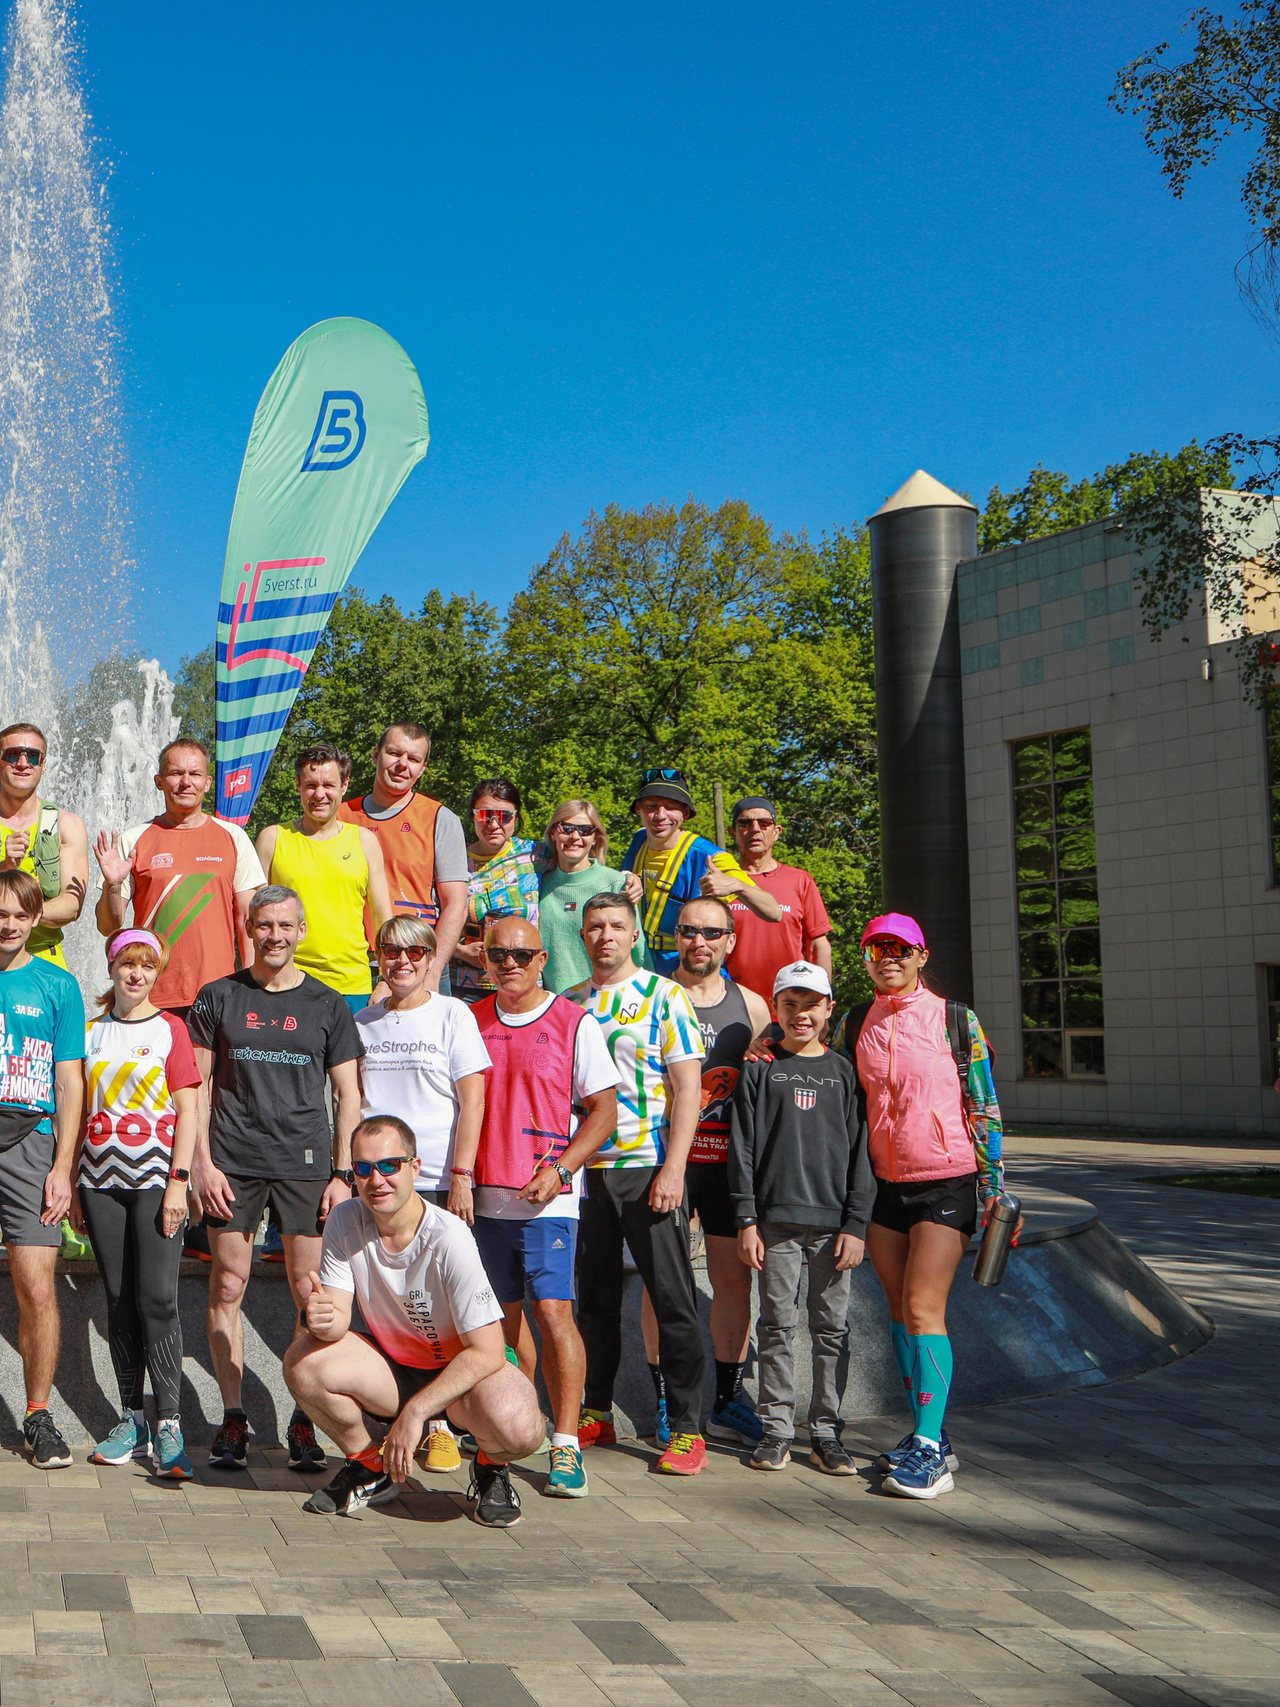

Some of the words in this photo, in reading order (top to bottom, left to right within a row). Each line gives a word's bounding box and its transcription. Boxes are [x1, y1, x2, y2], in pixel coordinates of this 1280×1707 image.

[264, 577, 317, 593] 5verst.ru
[699, 1023, 718, 1035] RA.
[703, 1036, 715, 1048] UN
[229, 1046, 312, 1066] ПЕЙСМЕЙКЕР
[771, 1073, 841, 1087] GANT
[692, 1135, 722, 1144] OLDEN
[409, 1290, 423, 1300] GRi
[416, 1302, 447, 1360] КРАСОЧНЫ
